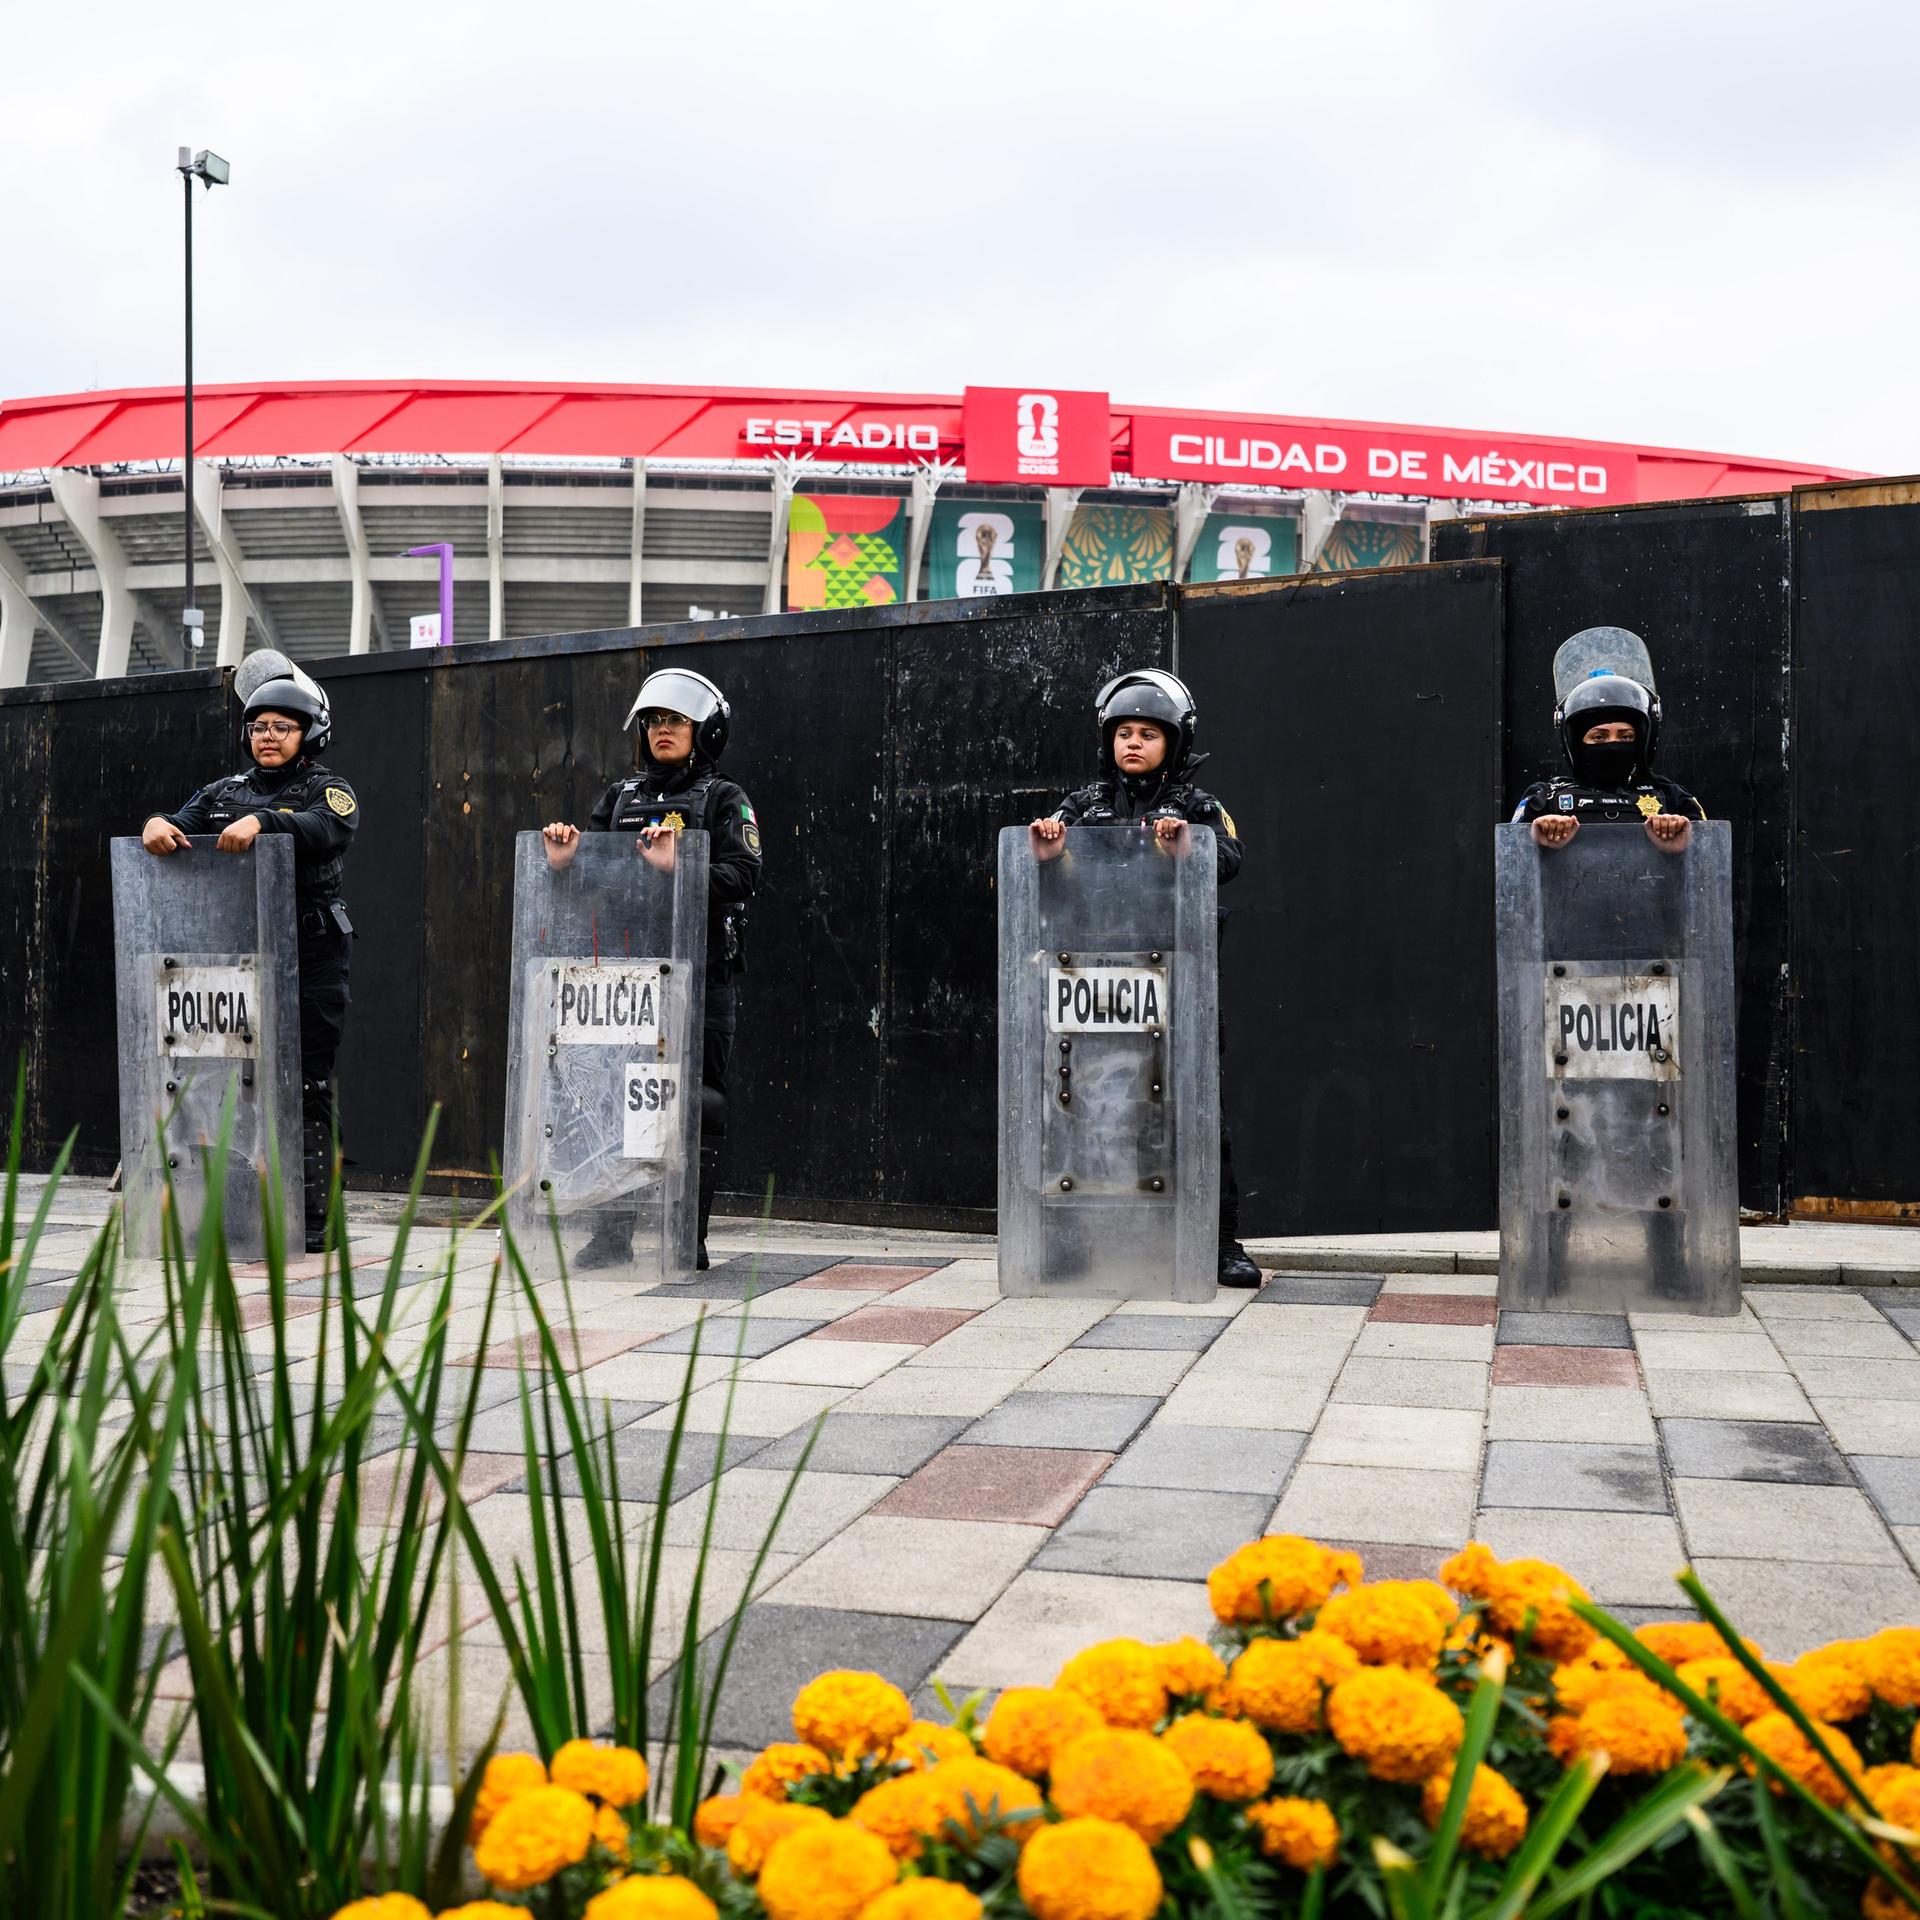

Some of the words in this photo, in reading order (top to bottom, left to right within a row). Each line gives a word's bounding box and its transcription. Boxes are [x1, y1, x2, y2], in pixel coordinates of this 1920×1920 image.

[746, 418, 939, 450] ESTADIO
[1018, 464, 1059, 475] 2026
[1169, 434, 1347, 474] CIUDAD
[1368, 449, 1428, 480] DE
[1443, 451, 1607, 494] MÉXICO
[972, 585, 998, 595] FIFA
[168, 991, 250, 1034] POLICIA
[561, 982, 655, 1026] POLICIA
[1057, 978, 1160, 1024] POLICIA
[1560, 1003, 1663, 1052] POLICIA
[628, 1078, 676, 1112] SSP
